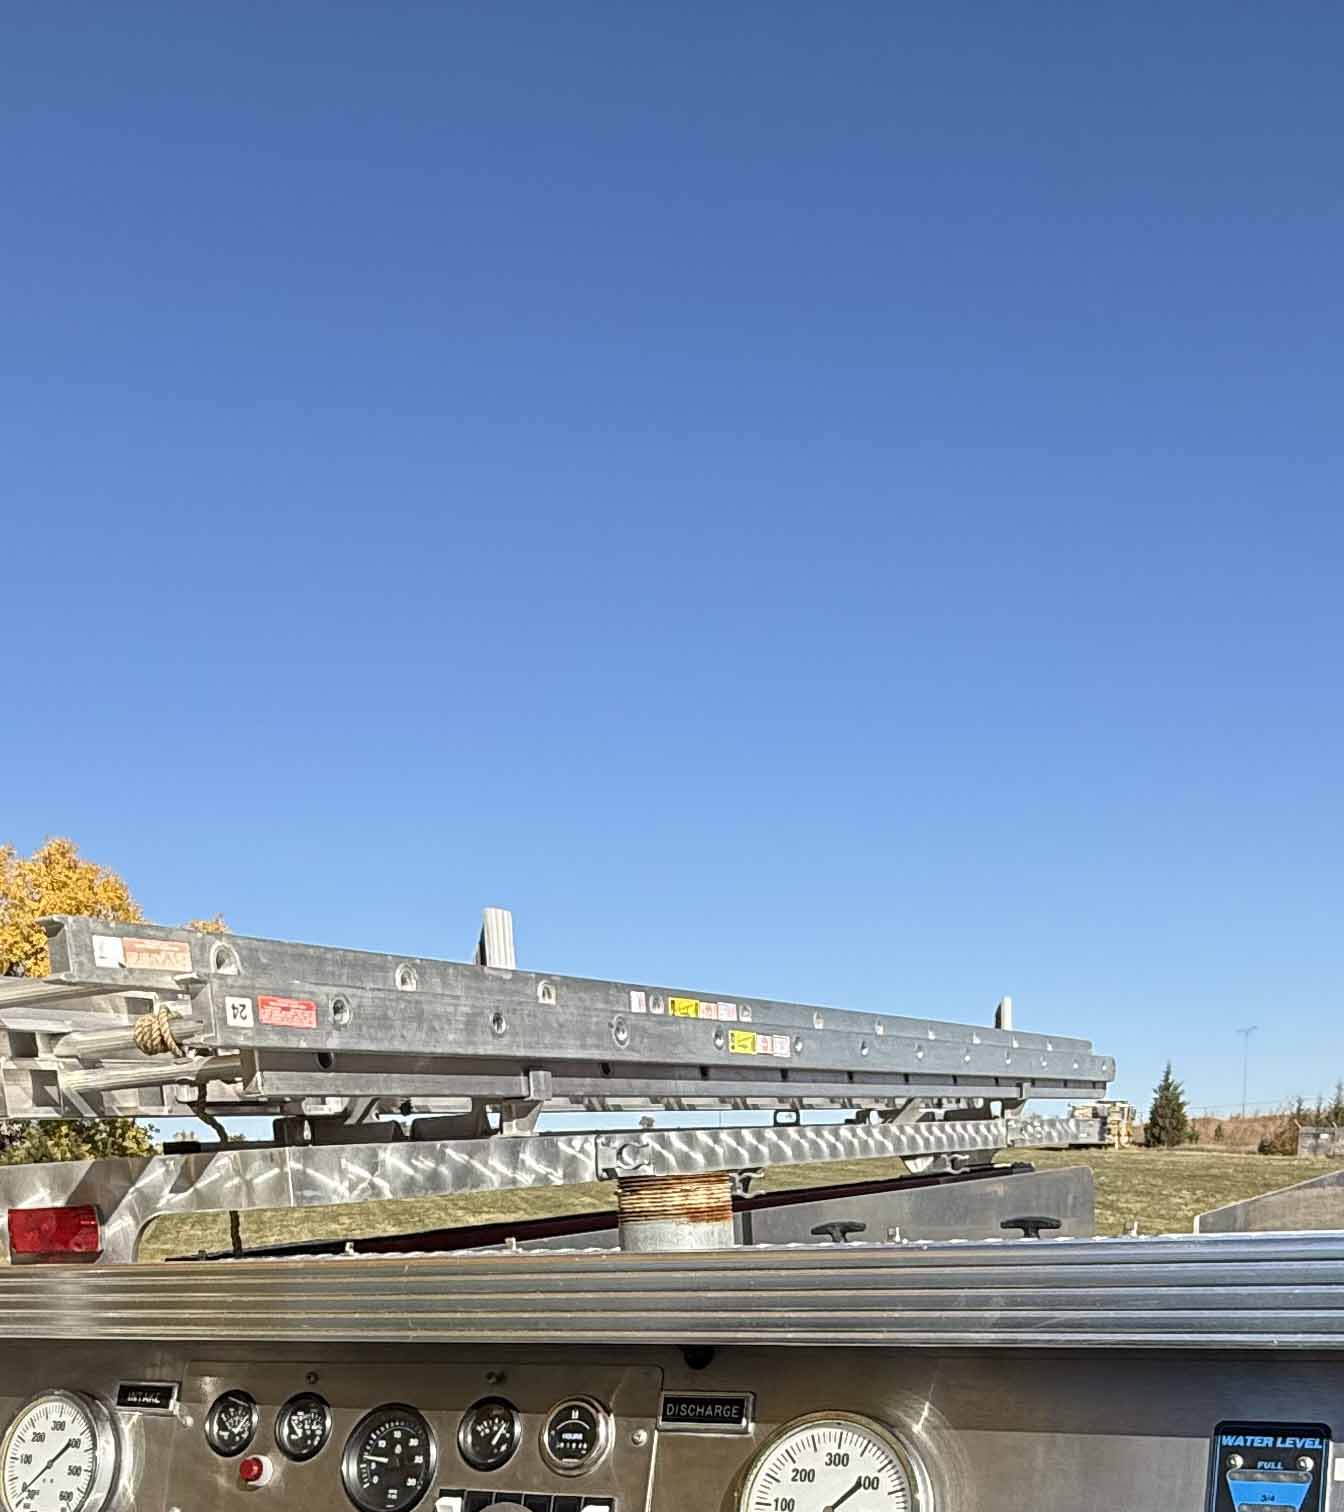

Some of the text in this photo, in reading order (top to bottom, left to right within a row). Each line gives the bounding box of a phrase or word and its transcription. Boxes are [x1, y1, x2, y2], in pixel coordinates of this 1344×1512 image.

[231, 1003, 247, 1020] 24
[666, 1403, 741, 1418] DISCHARGE
[51, 1420, 66, 1431] 300
[1222, 1436, 1323, 1449] WATER LEVEL
[20, 1454, 32, 1464] 100
[825, 1452, 850, 1467] 300
[1257, 1461, 1284, 1470] FULL
[67, 1465, 82, 1476] 500
[791, 1468, 816, 1482] 200
[59, 1490, 73, 1502] 600
[773, 1498, 795, 1512] 100
